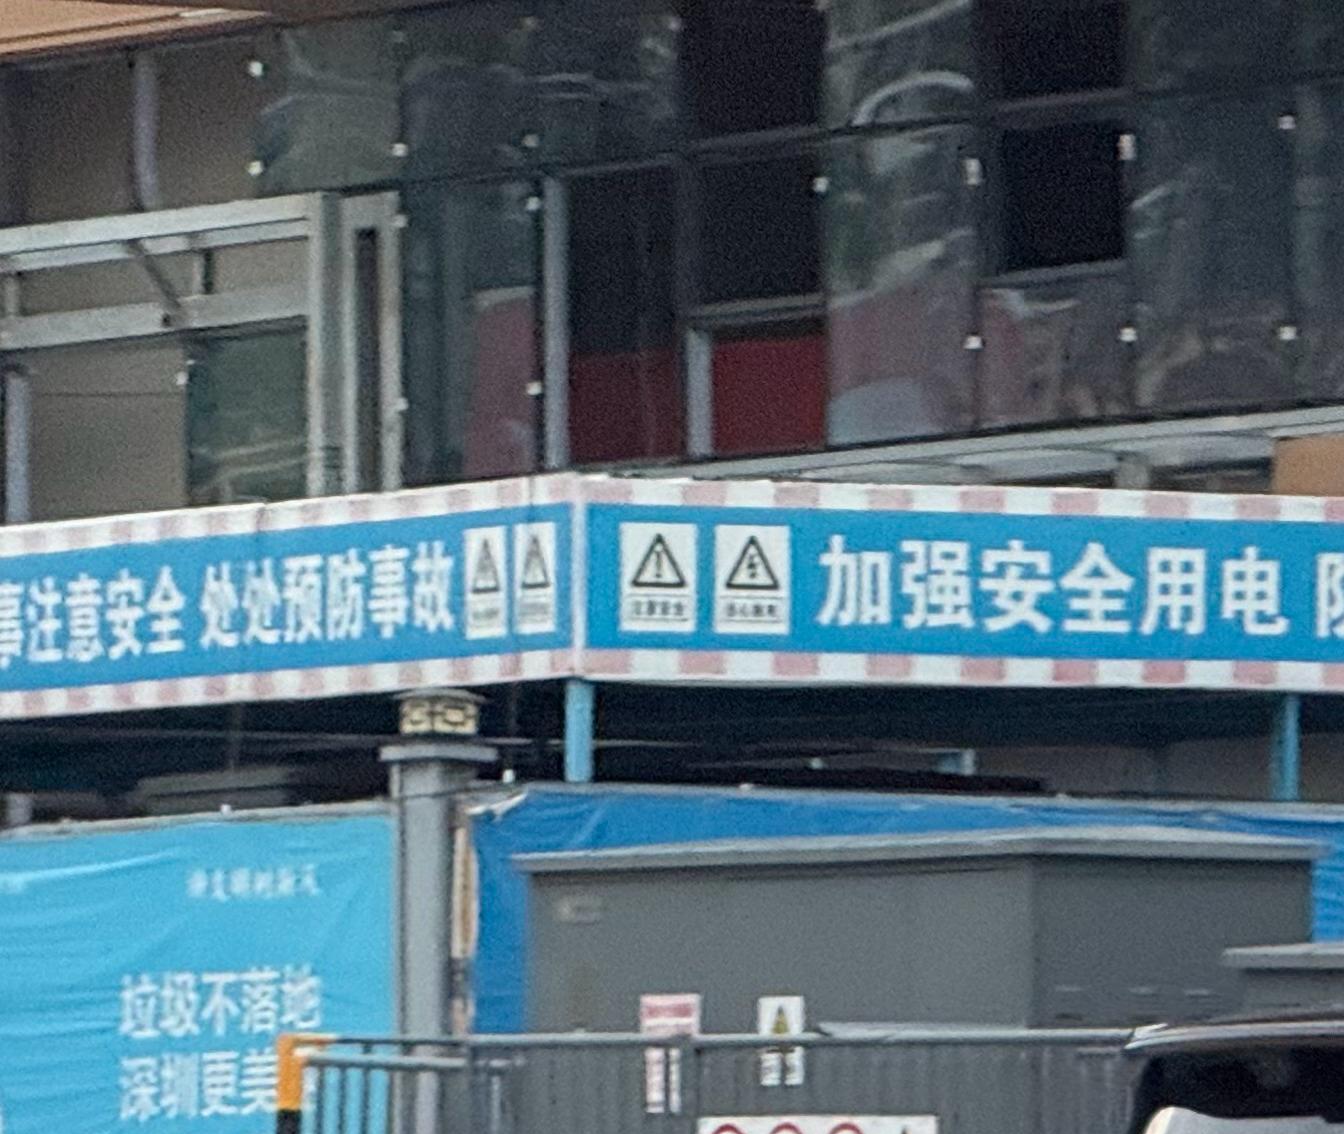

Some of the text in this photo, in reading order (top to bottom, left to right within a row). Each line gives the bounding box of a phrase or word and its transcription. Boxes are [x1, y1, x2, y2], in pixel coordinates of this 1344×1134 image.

[200, 540, 455, 650] 处处预防事故
[817, 534, 1290, 637] 加强安全用电
[118, 963, 323, 1039] 垃圾不落地
